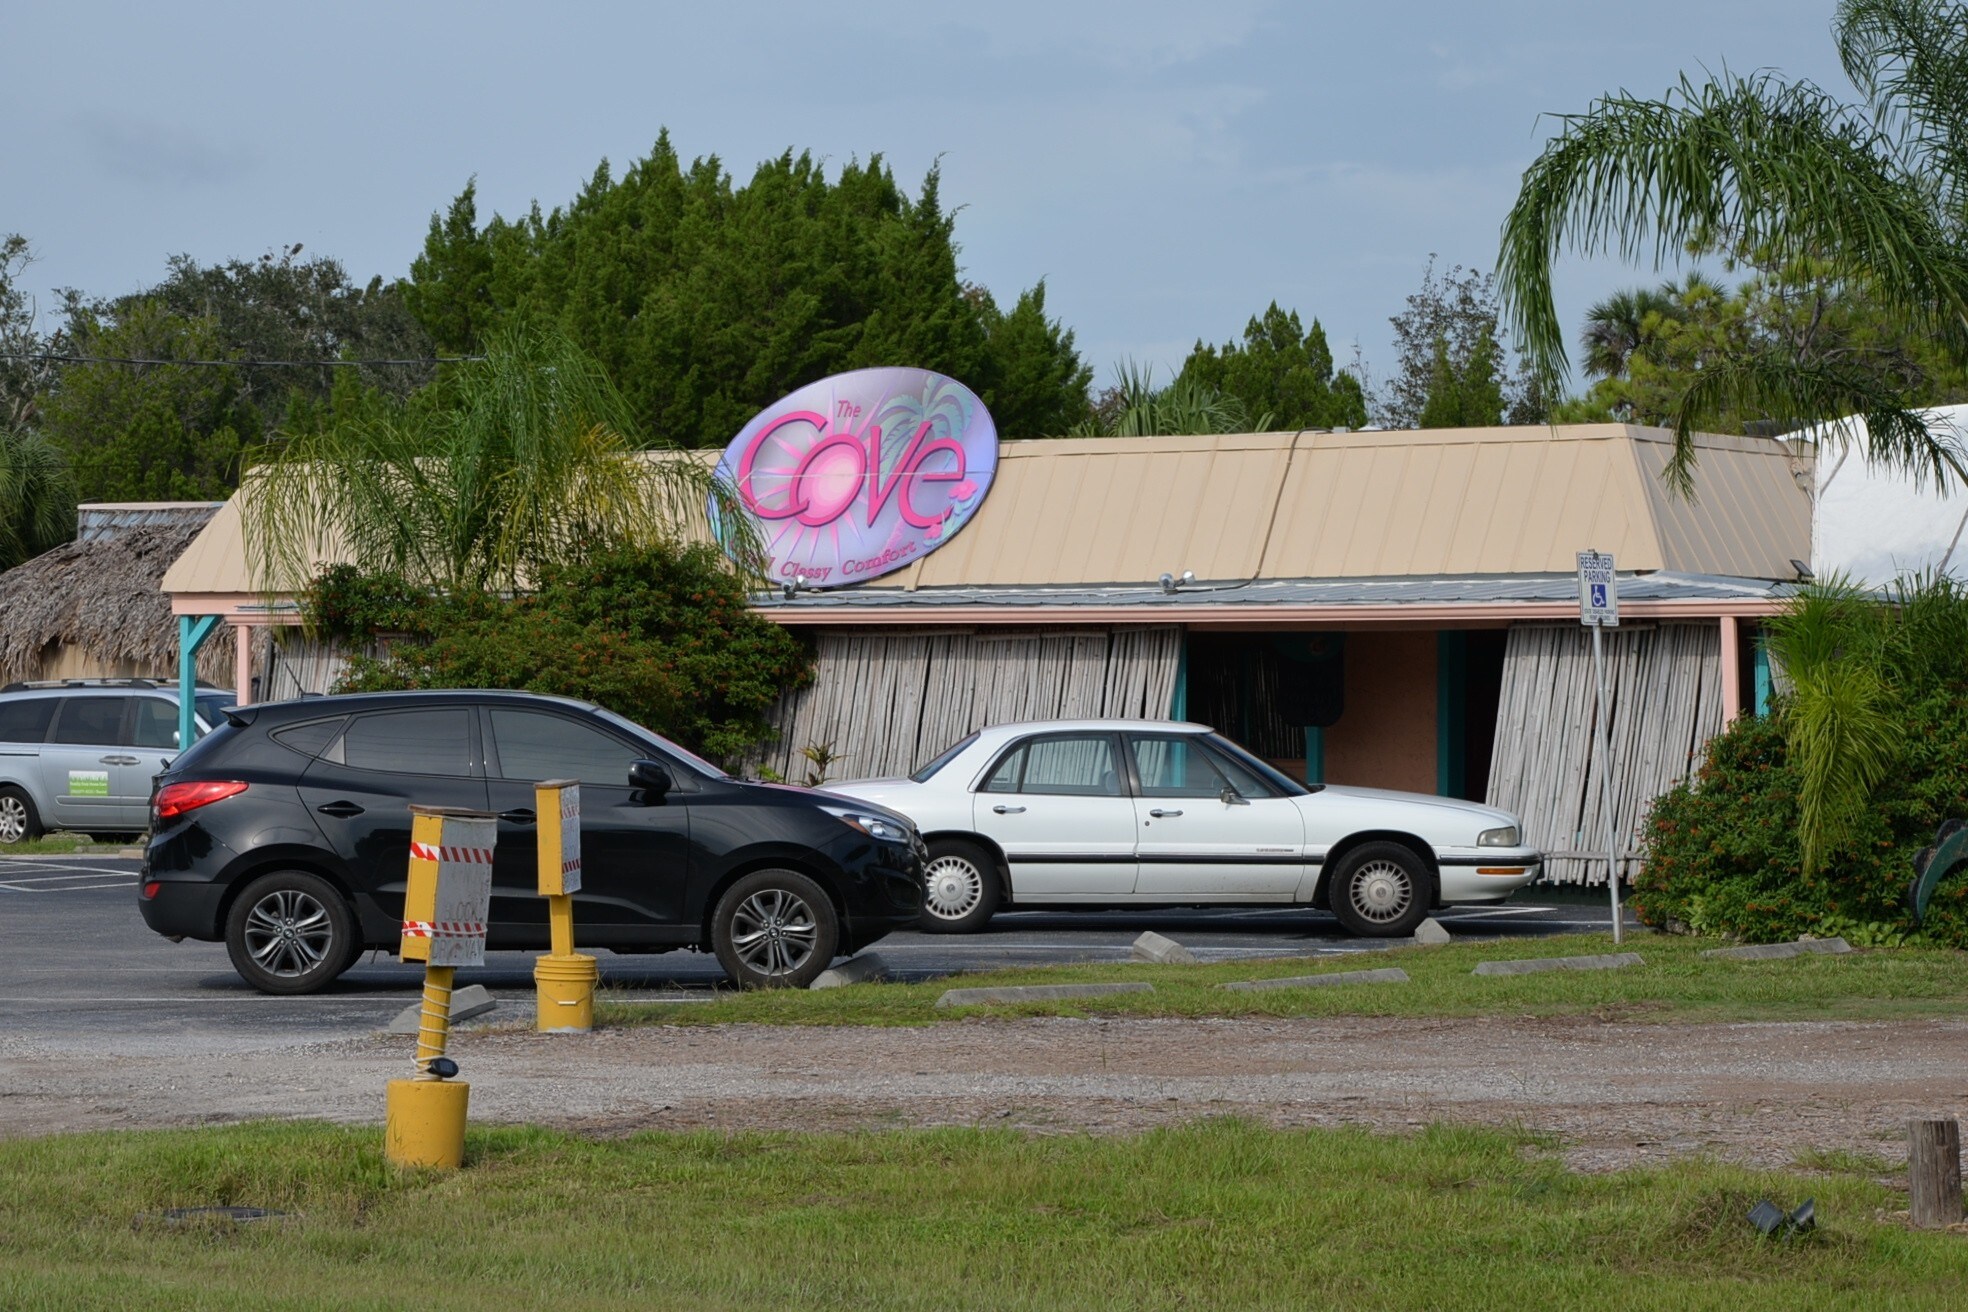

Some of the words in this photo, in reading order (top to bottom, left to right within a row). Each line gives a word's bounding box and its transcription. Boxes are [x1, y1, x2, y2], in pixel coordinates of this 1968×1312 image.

[837, 400, 861, 417] The
[780, 561, 832, 582] Classy
[842, 541, 917, 575] Comfort
[1580, 556, 1612, 570] RESERVED
[1584, 570, 1611, 583] PARKING
